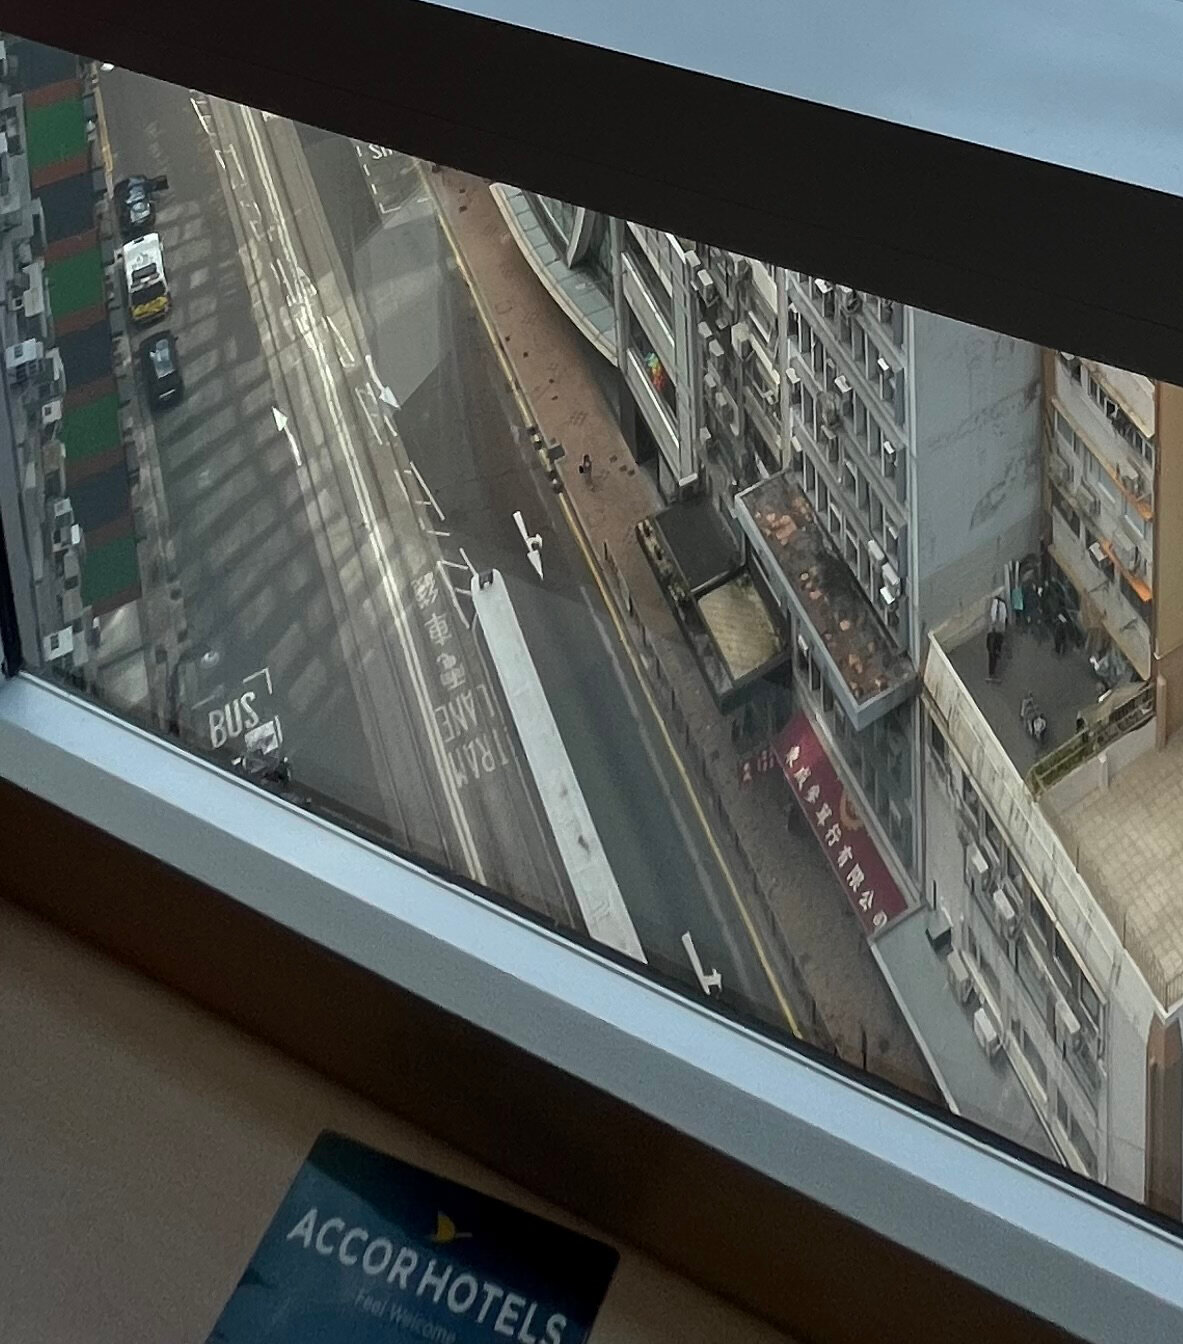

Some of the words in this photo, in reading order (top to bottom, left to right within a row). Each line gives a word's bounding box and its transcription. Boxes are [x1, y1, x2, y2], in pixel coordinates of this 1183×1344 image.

[208, 691, 259, 749] BUS
[435, 684, 495, 743] LANE
[448, 728, 509, 789] TRAM
[286, 1206, 567, 1344] ACCORHOTELS
